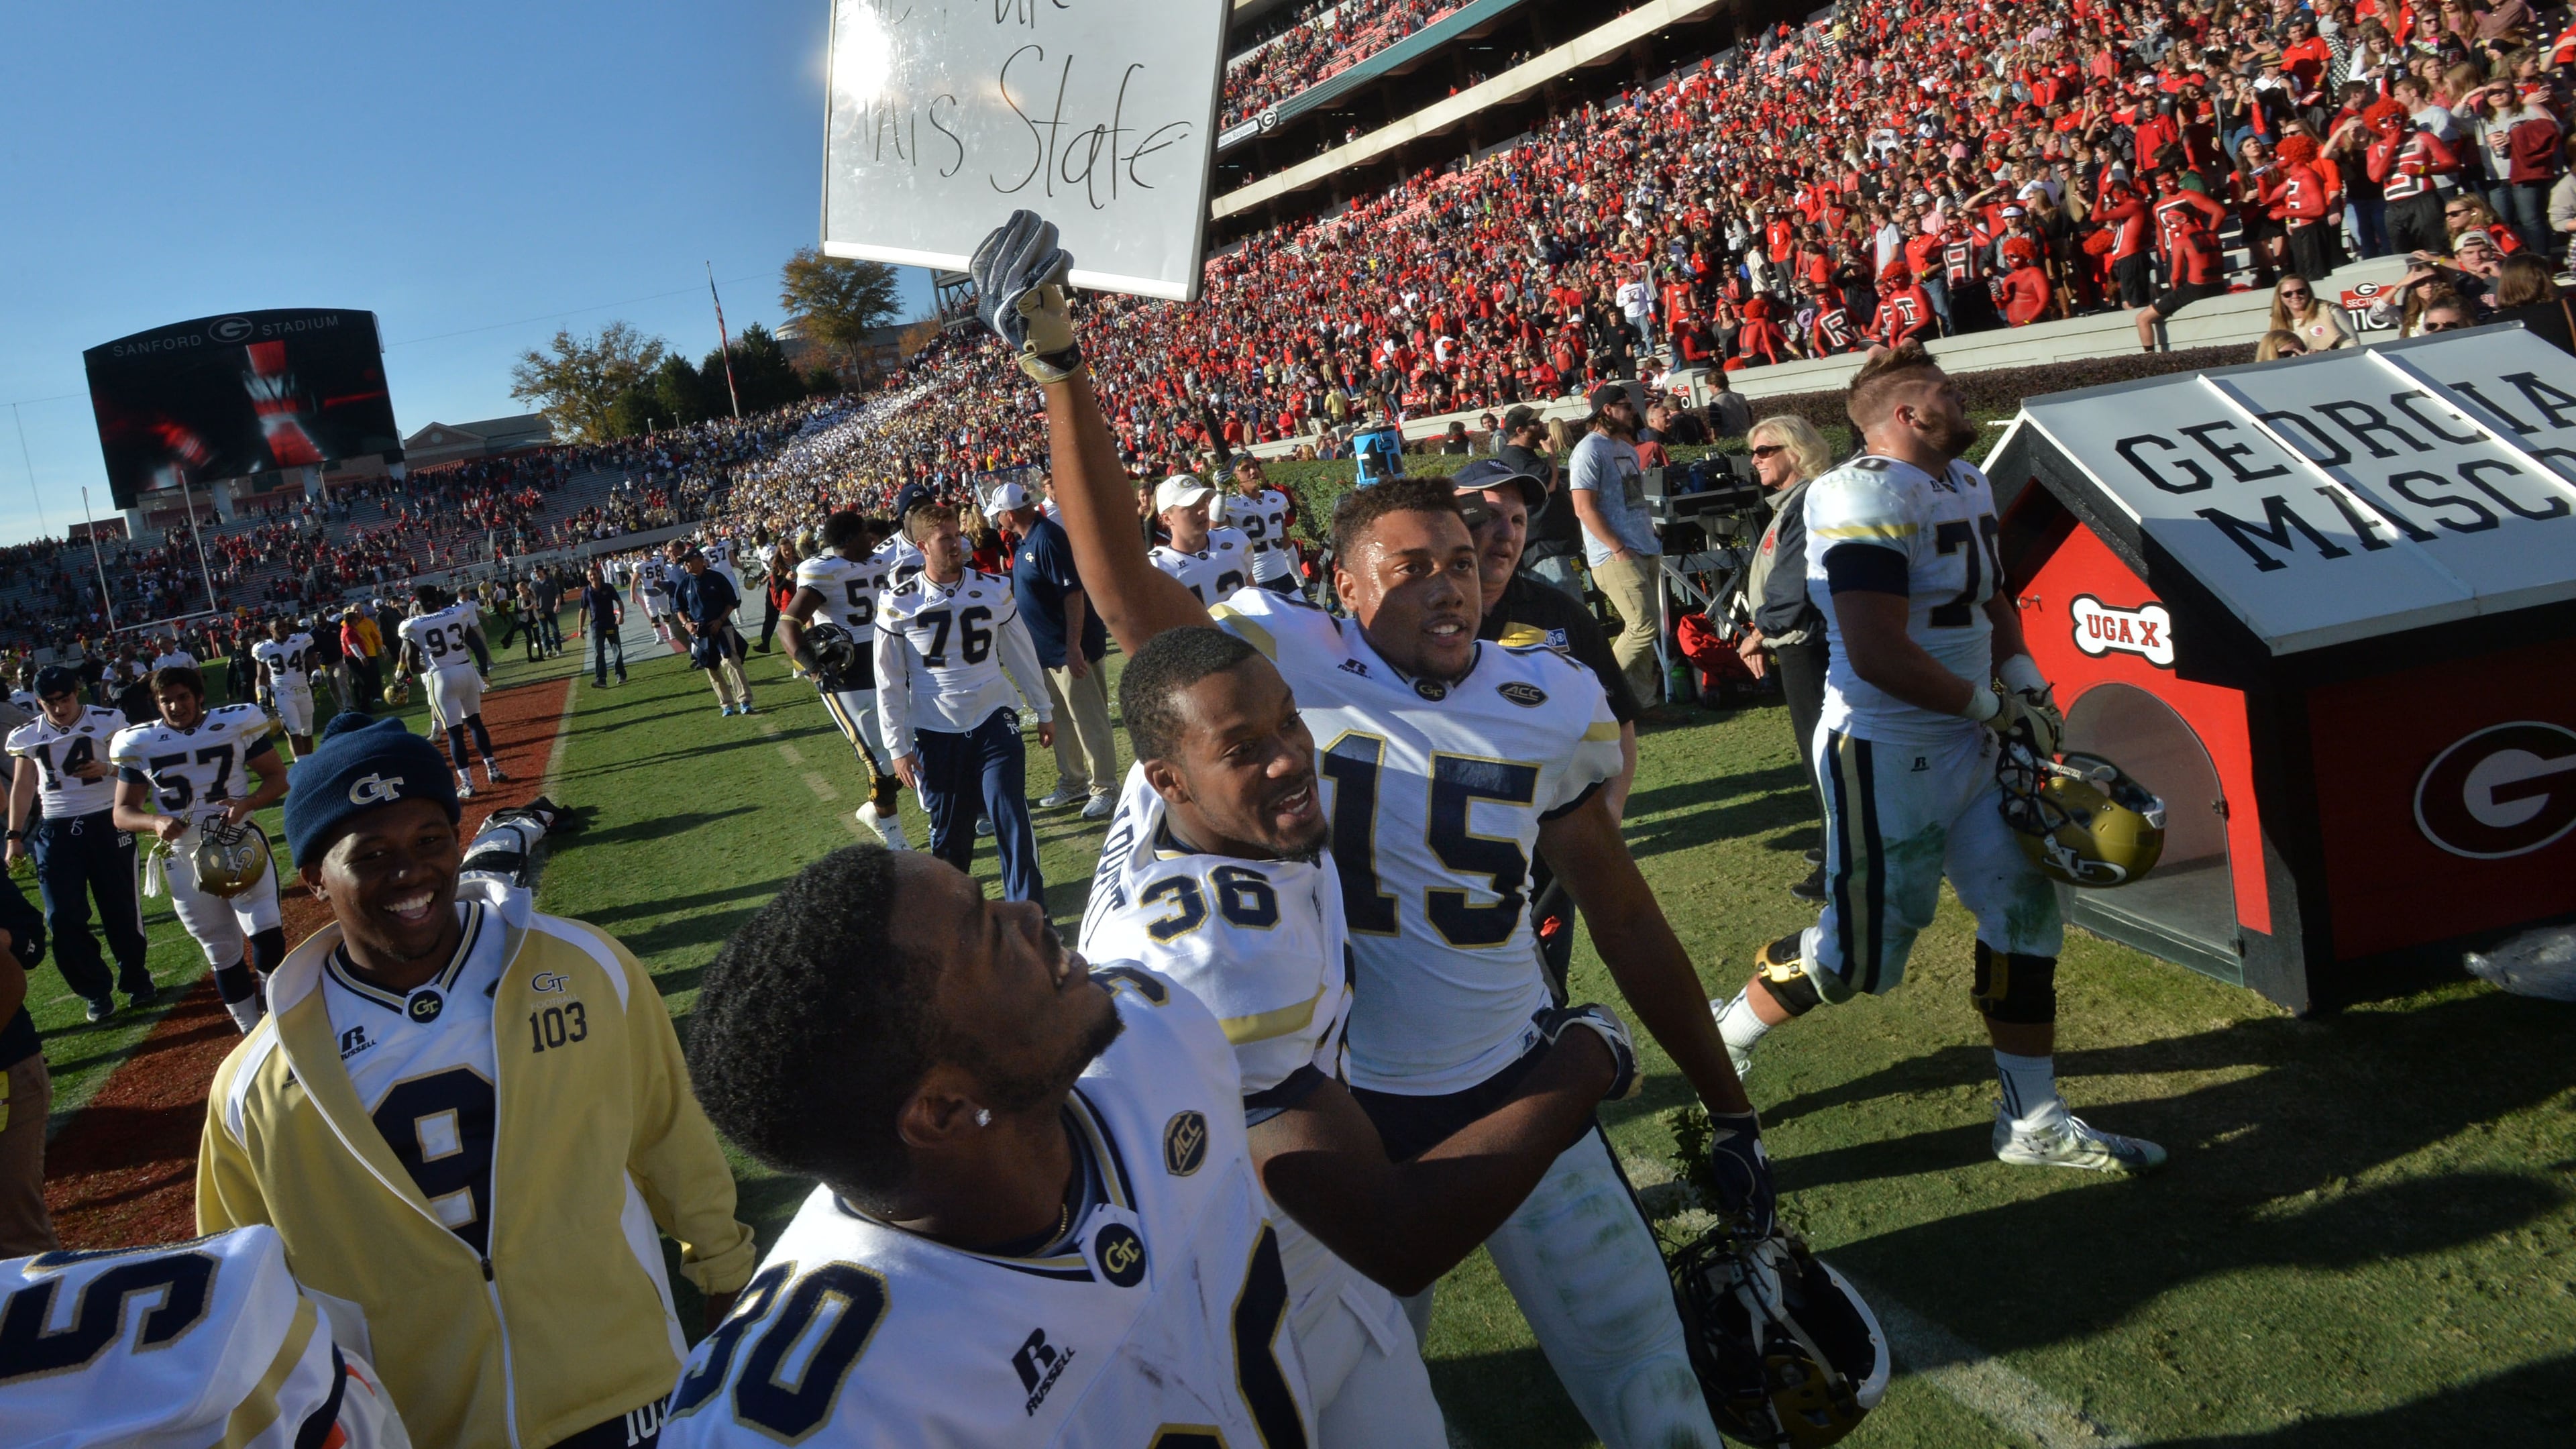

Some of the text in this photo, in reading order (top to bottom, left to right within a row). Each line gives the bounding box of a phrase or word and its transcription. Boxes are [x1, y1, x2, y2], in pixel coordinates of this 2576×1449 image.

[990, 44, 1192, 209] State
[1773, 230, 1779, 245] 1
[113, 335, 202, 358] SANFORD
[262, 315, 339, 335] STADIUM
[2114, 371, 2576, 494] GEORGIA
[645, 564, 664, 580] 68
[708, 547, 727, 563] 57
[425, 623, 465, 657] 93
[916, 605, 993, 667] 76
[2086, 614, 2161, 648] UGA X
[269, 649, 304, 676] 94
[1503, 685, 1541, 700] ACC
[36, 736, 97, 792] 14
[148, 743, 233, 811] 57
[349, 772, 405, 805] GT
[1319, 729, 1543, 950] 15
[1140, 865, 1281, 945] 36
[531, 971, 569, 994] GT
[413, 998, 439, 1016] GT
[529, 1000, 588, 1054] 103
[370, 1063, 496, 1259] 9
[1174, 1113, 1201, 1167] ACC
[1104, 1235, 1143, 1277] GT
[668, 1260, 892, 1448] 30
[1025, 1346, 1076, 1417] RUSSELL
